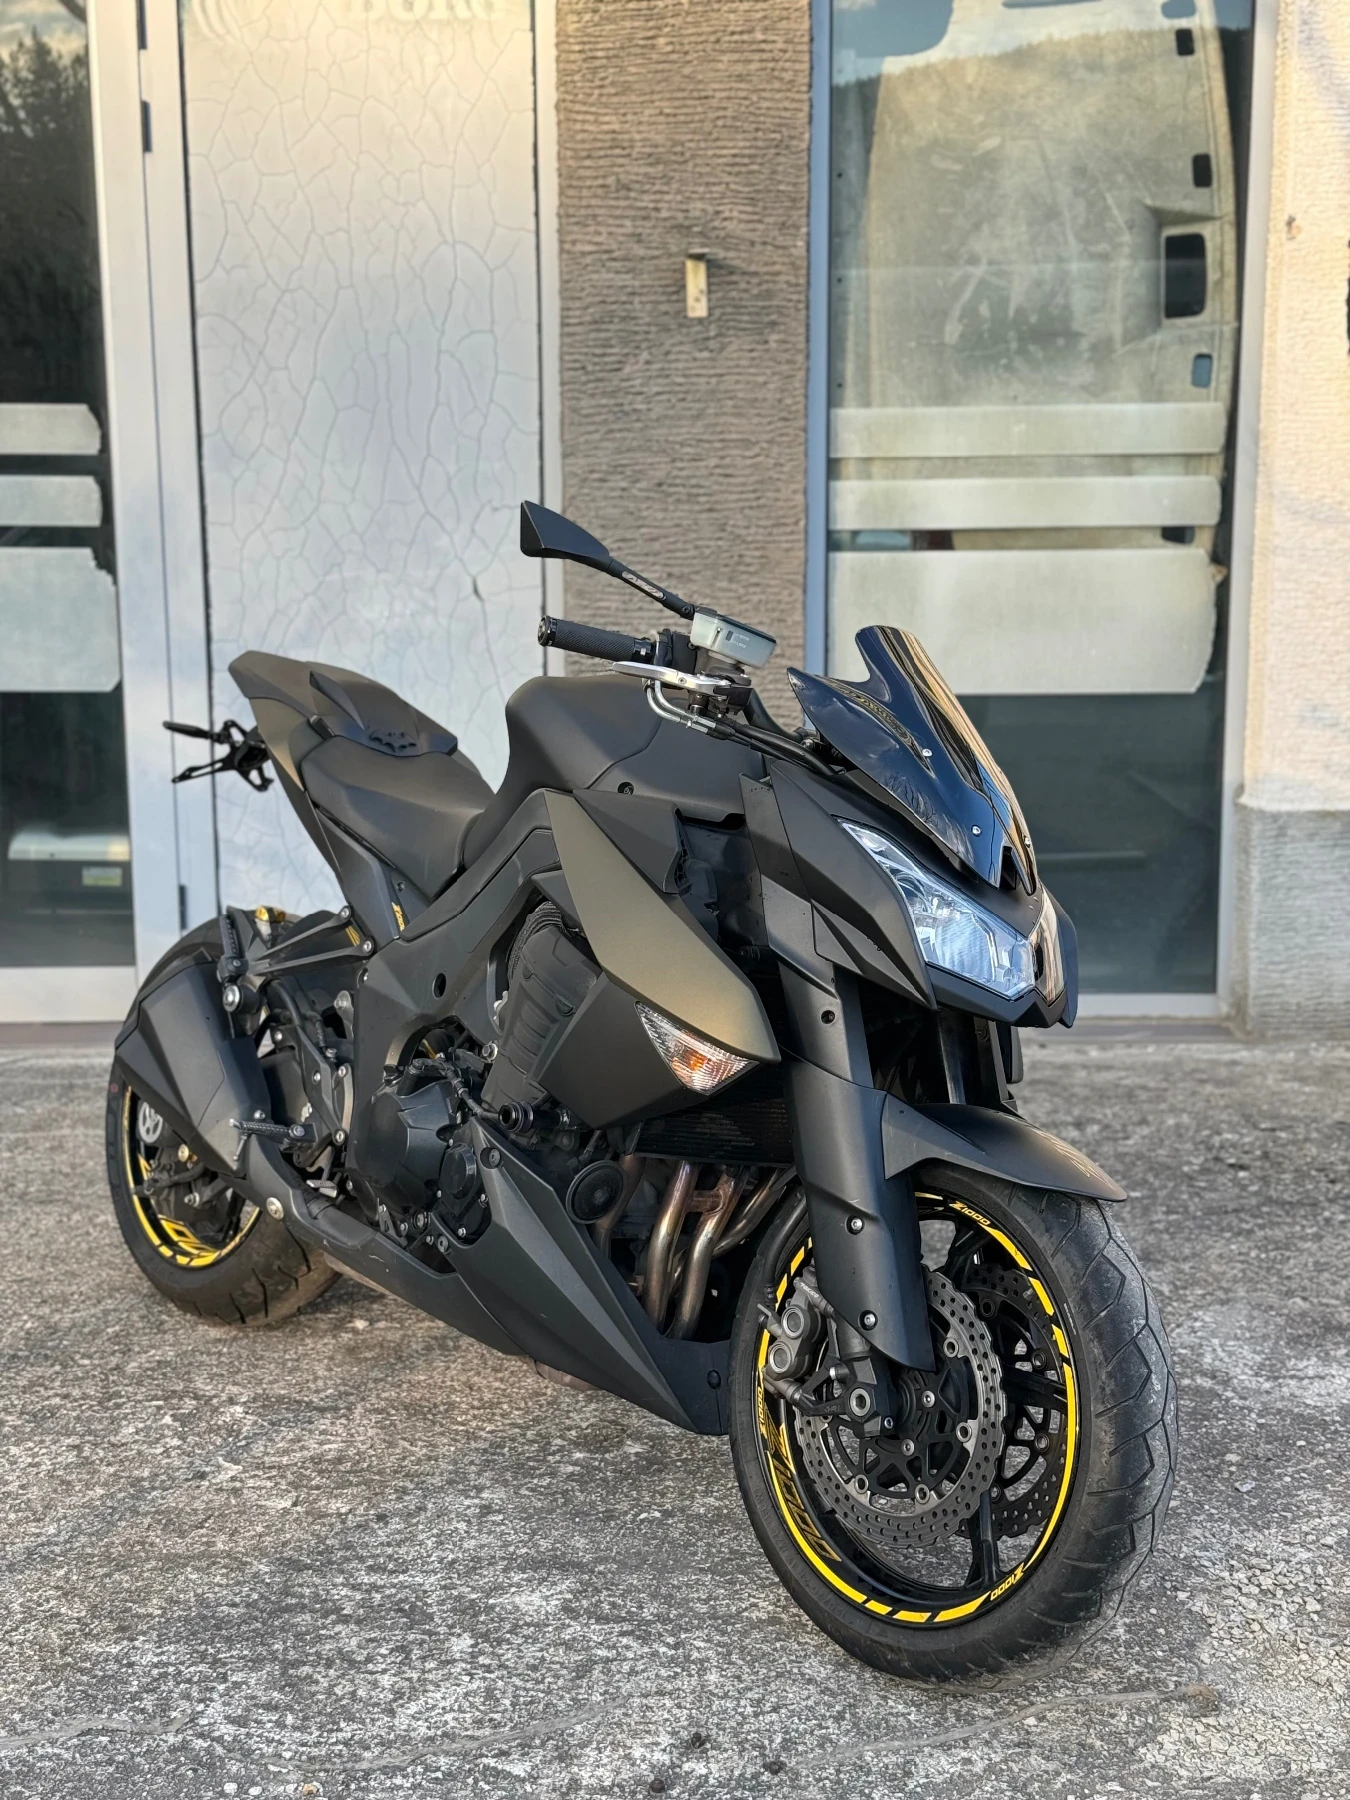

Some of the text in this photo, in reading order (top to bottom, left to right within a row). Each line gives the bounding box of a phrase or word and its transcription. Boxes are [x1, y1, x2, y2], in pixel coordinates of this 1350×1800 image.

[948, 1200, 991, 1226] Z1000
[757, 1386, 768, 1440] Z1000
[763, 1401, 843, 1562] Z1000
[990, 1562, 1025, 1601] Z1000
